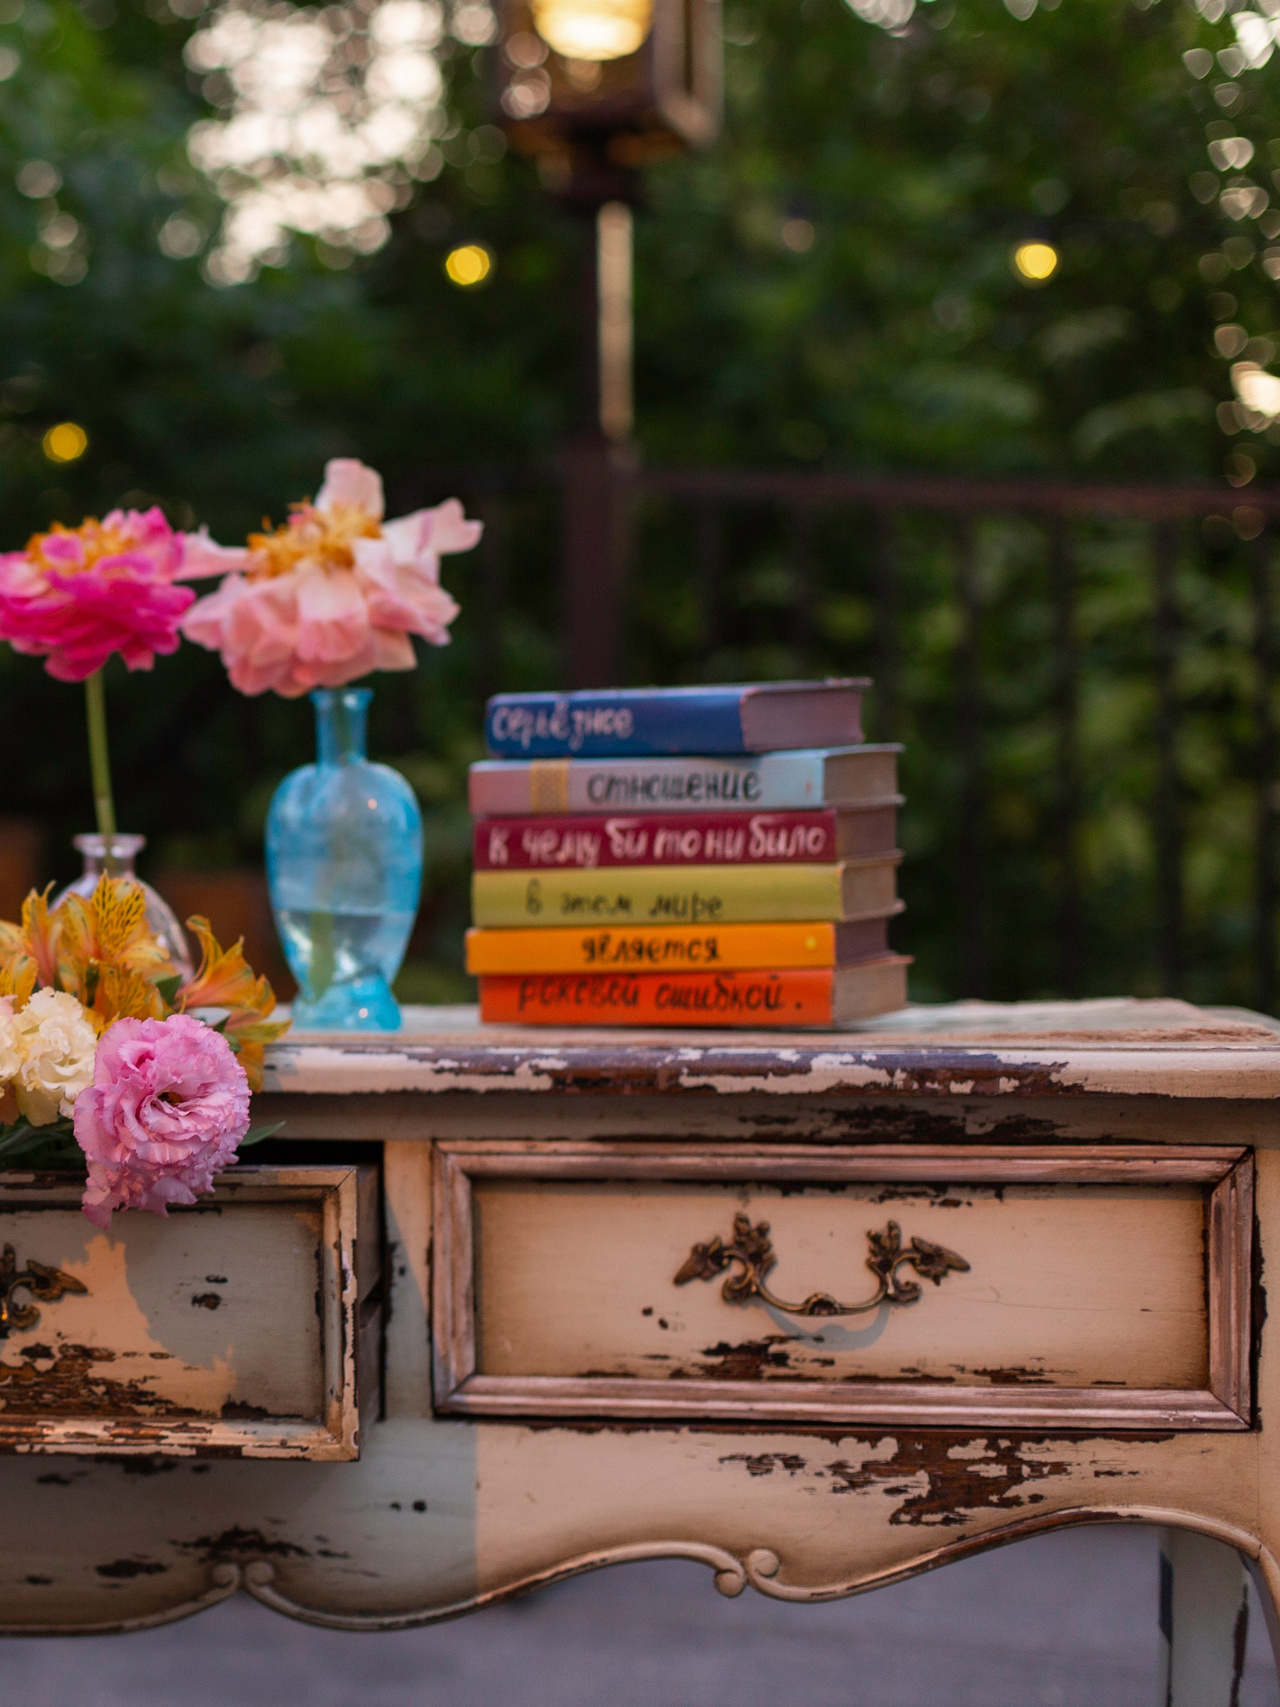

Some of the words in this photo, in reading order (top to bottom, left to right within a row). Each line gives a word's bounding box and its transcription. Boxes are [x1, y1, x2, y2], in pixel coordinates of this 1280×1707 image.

[586, 771, 762, 804] отношение
[522, 827, 602, 868] чему
[653, 827, 702, 860] то
[704, 826, 746, 860] ни
[749, 814, 826, 858] было
[648, 891, 723, 923] мире
[581, 933, 721, 964] является
[518, 972, 639, 1011] роковой
